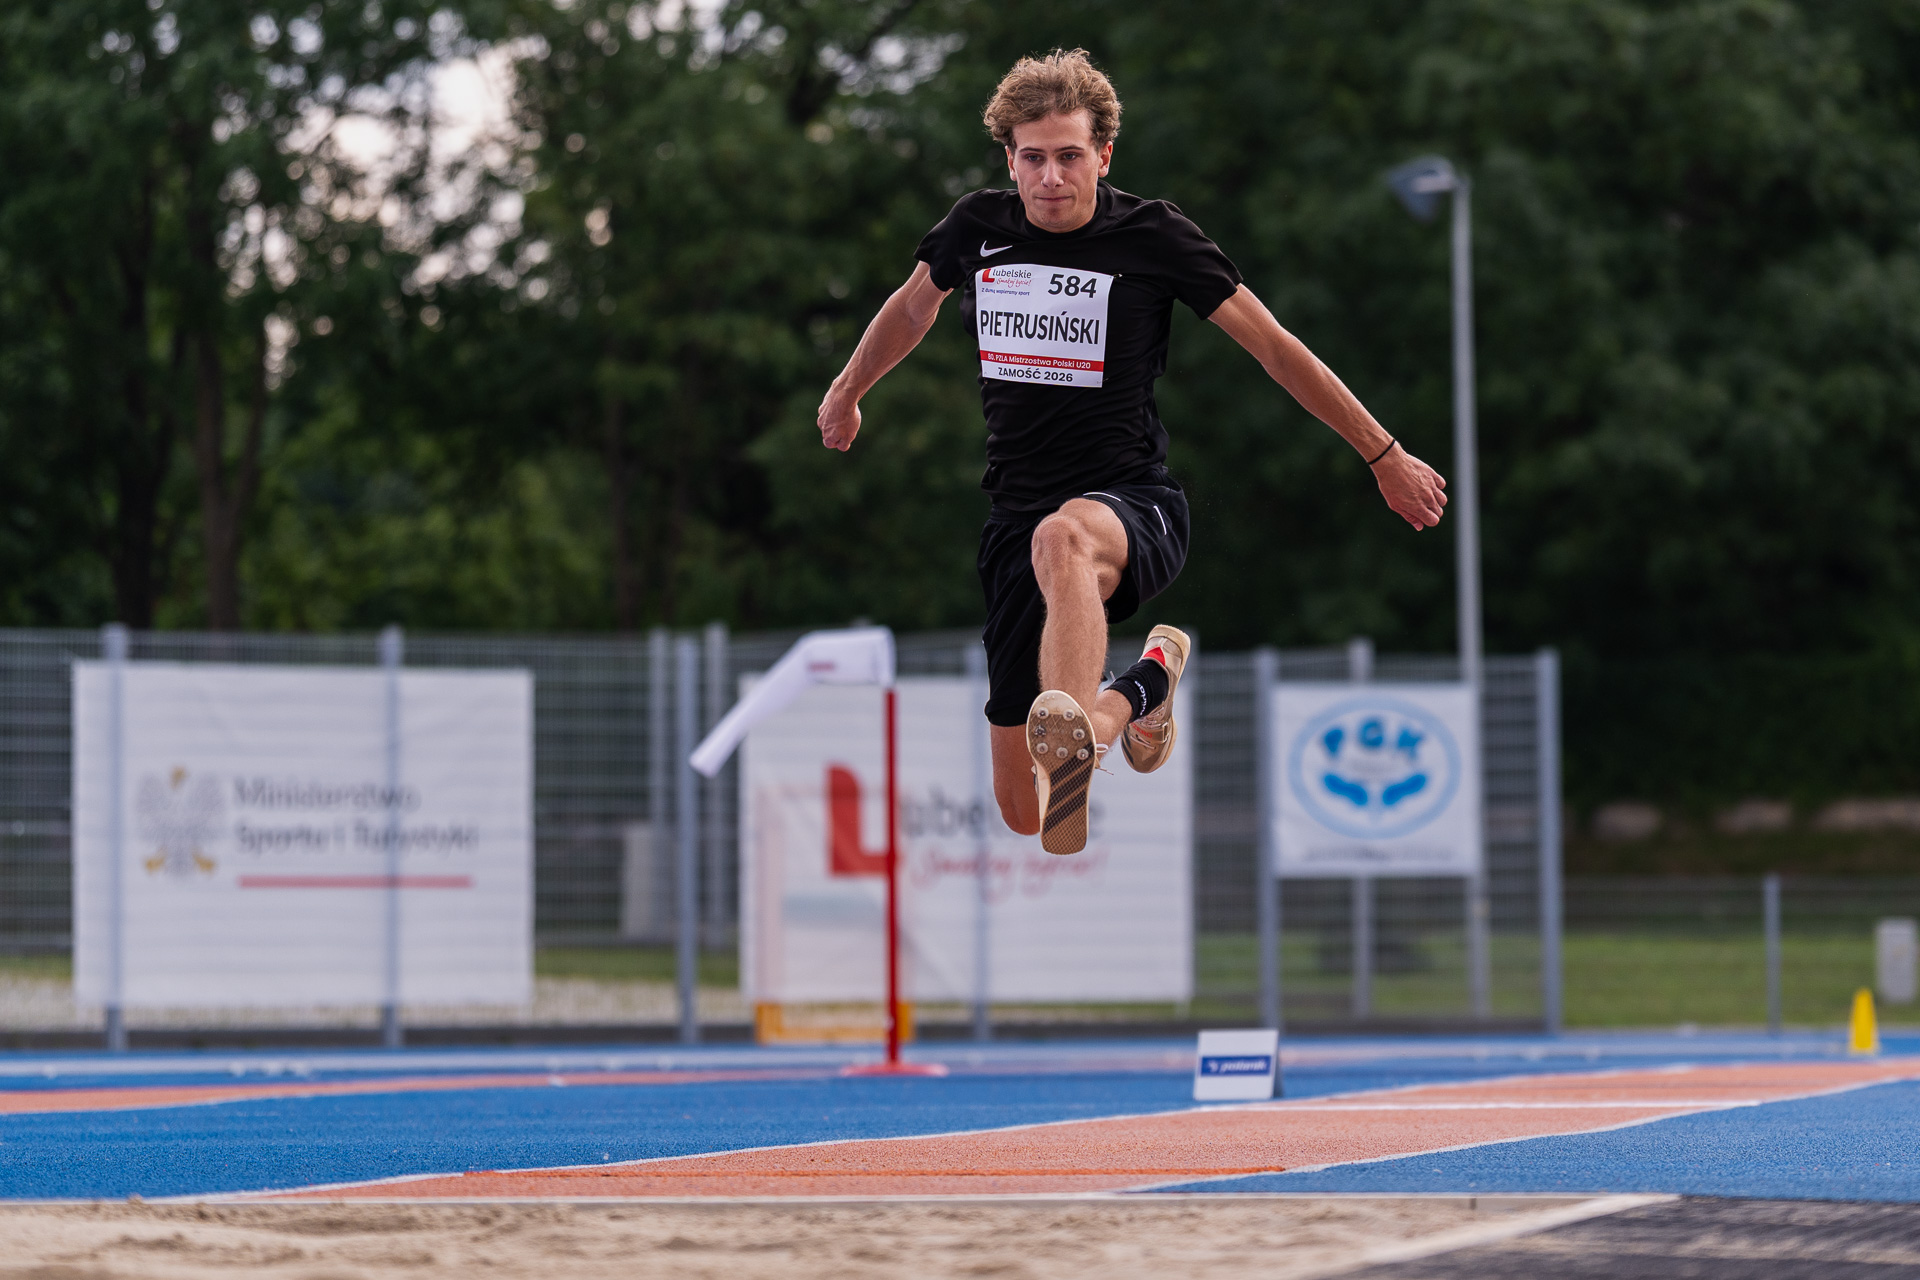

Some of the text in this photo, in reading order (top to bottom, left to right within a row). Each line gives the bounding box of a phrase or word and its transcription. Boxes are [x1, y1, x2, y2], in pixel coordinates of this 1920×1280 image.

[992, 268, 1032, 279] lubelskie
[1048, 273, 1097, 299] 584
[980, 309, 1100, 345] PIETRUSIŃSKI
[995, 354, 1008, 362] PZLA
[1008, 355, 1052, 366] Mistrzostwa
[1052, 359, 1075, 368] Polski
[1076, 361, 1091, 369] U20
[998, 366, 1073, 382] ZAMOŚĆ 2026
